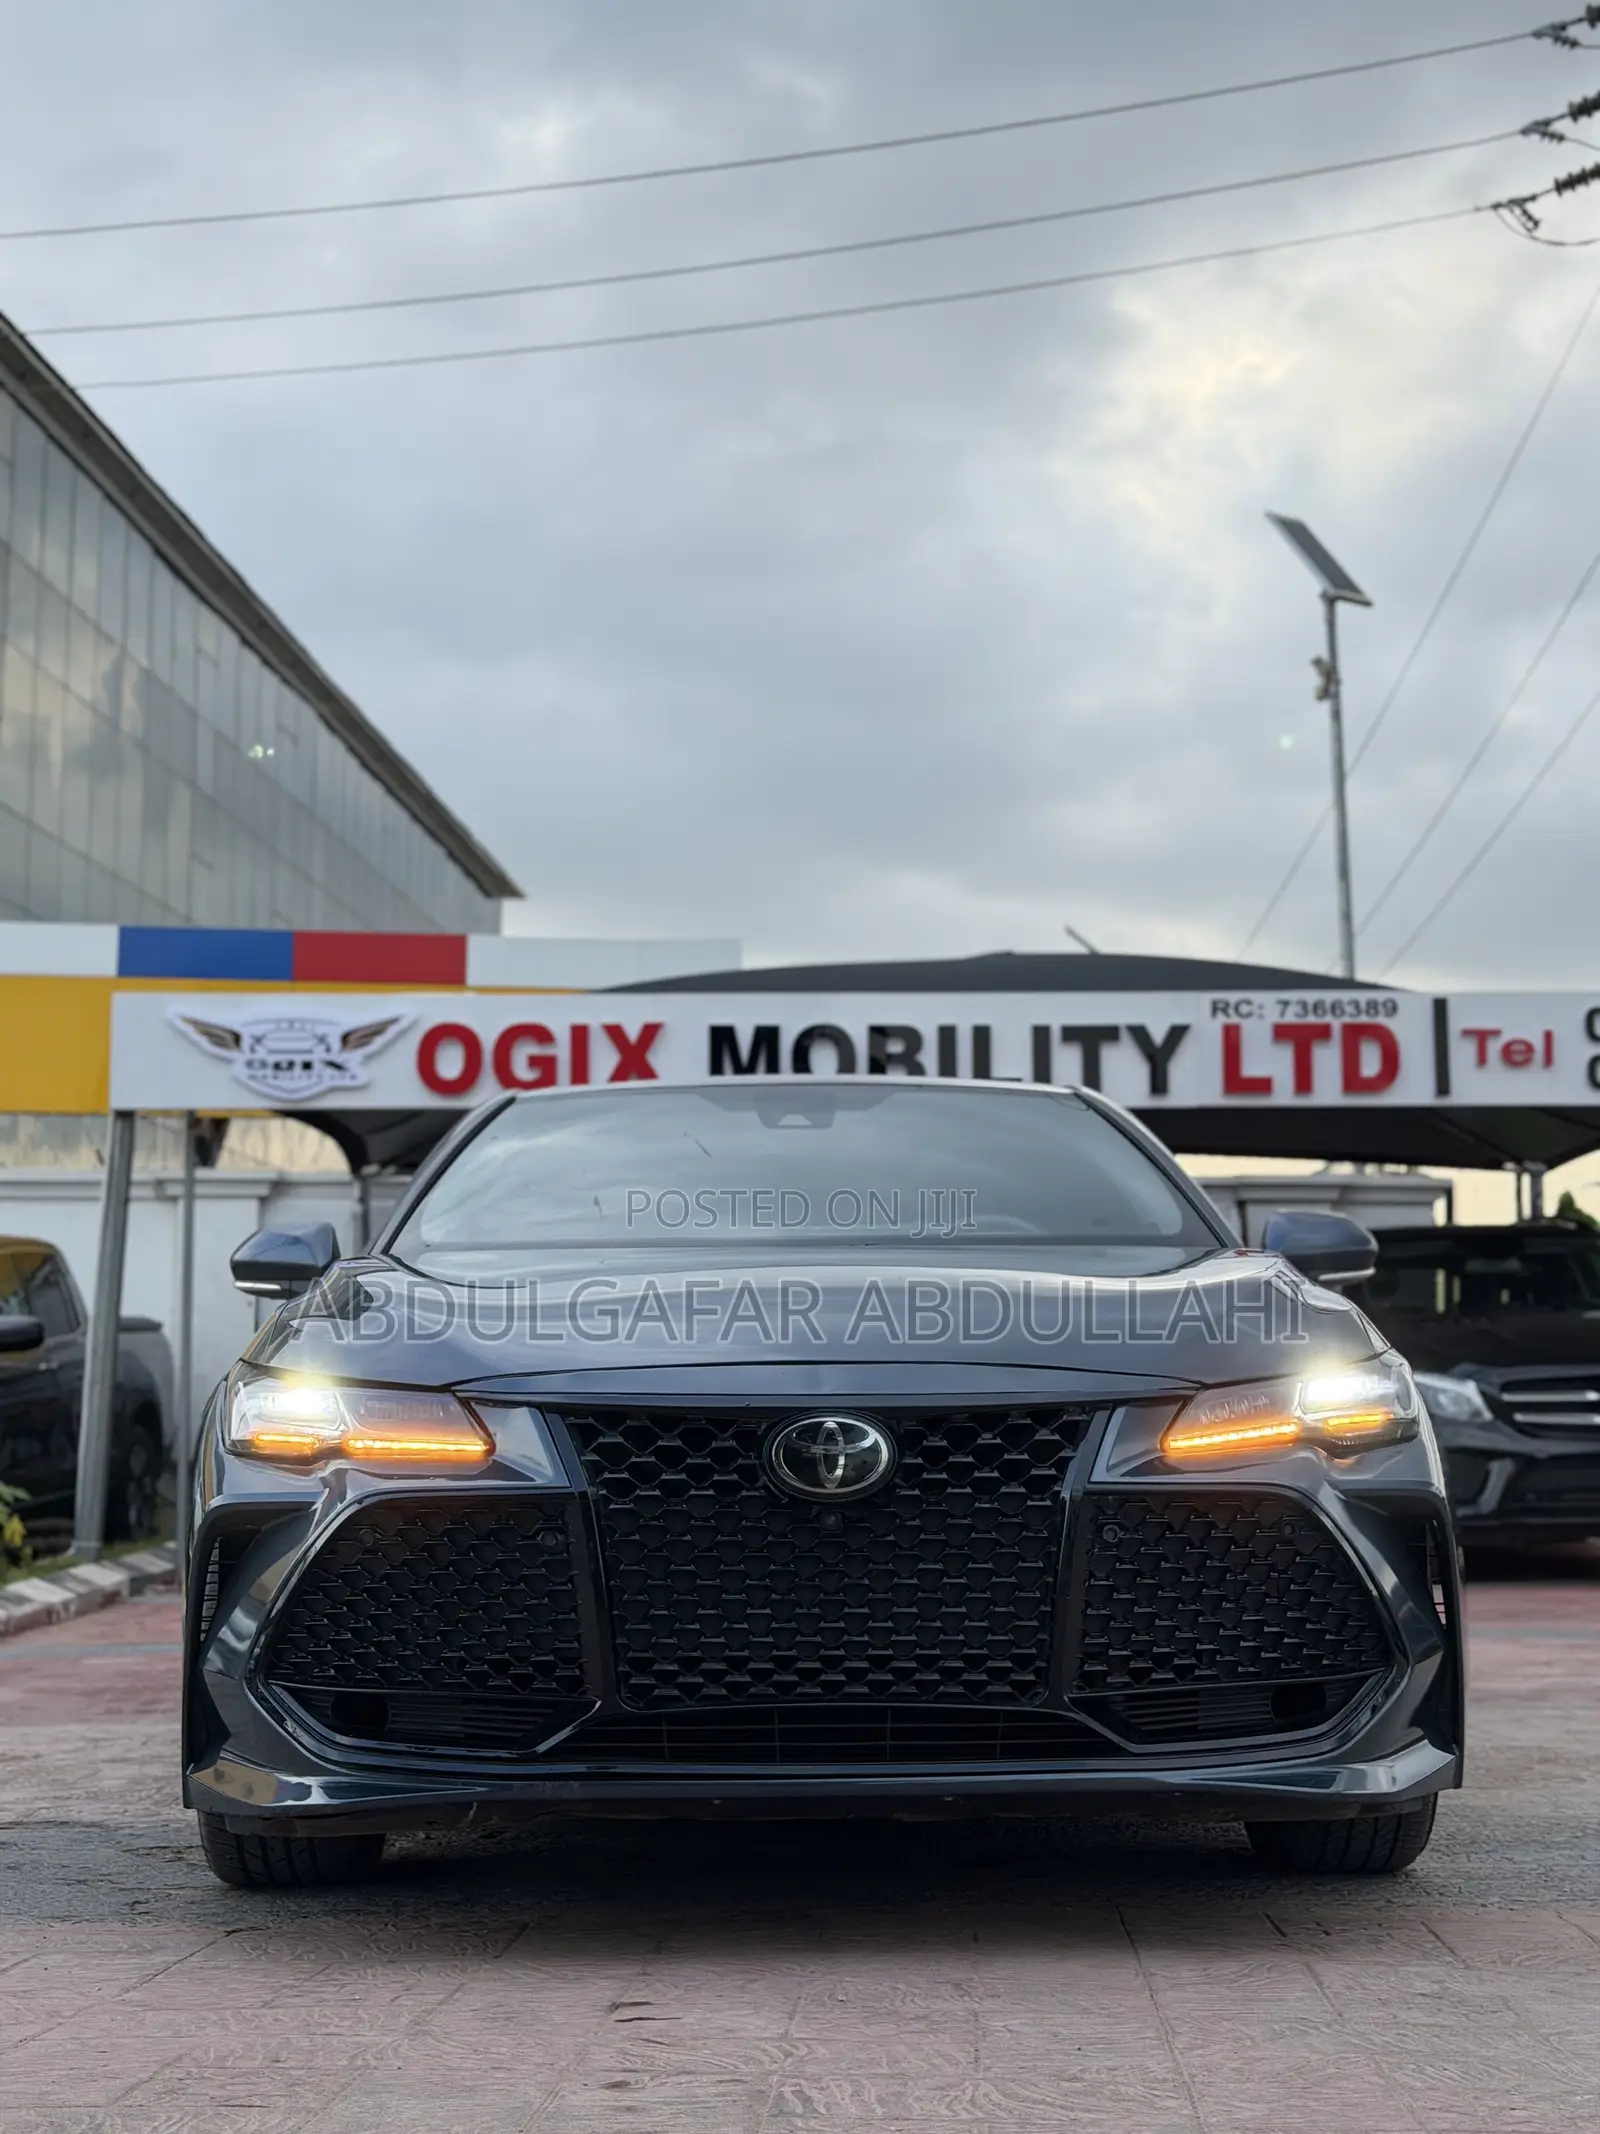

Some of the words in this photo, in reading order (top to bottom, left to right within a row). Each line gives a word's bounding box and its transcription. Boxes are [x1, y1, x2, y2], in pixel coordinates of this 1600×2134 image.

[1210, 996, 1267, 1020] RC:
[1275, 996, 1399, 1020] 7366389
[415, 1021, 665, 1097] OGIX
[708, 1023, 1191, 1096] MOBILITY
[1221, 1022, 1401, 1096] LTD
[1460, 1028, 1554, 1069] Tel
